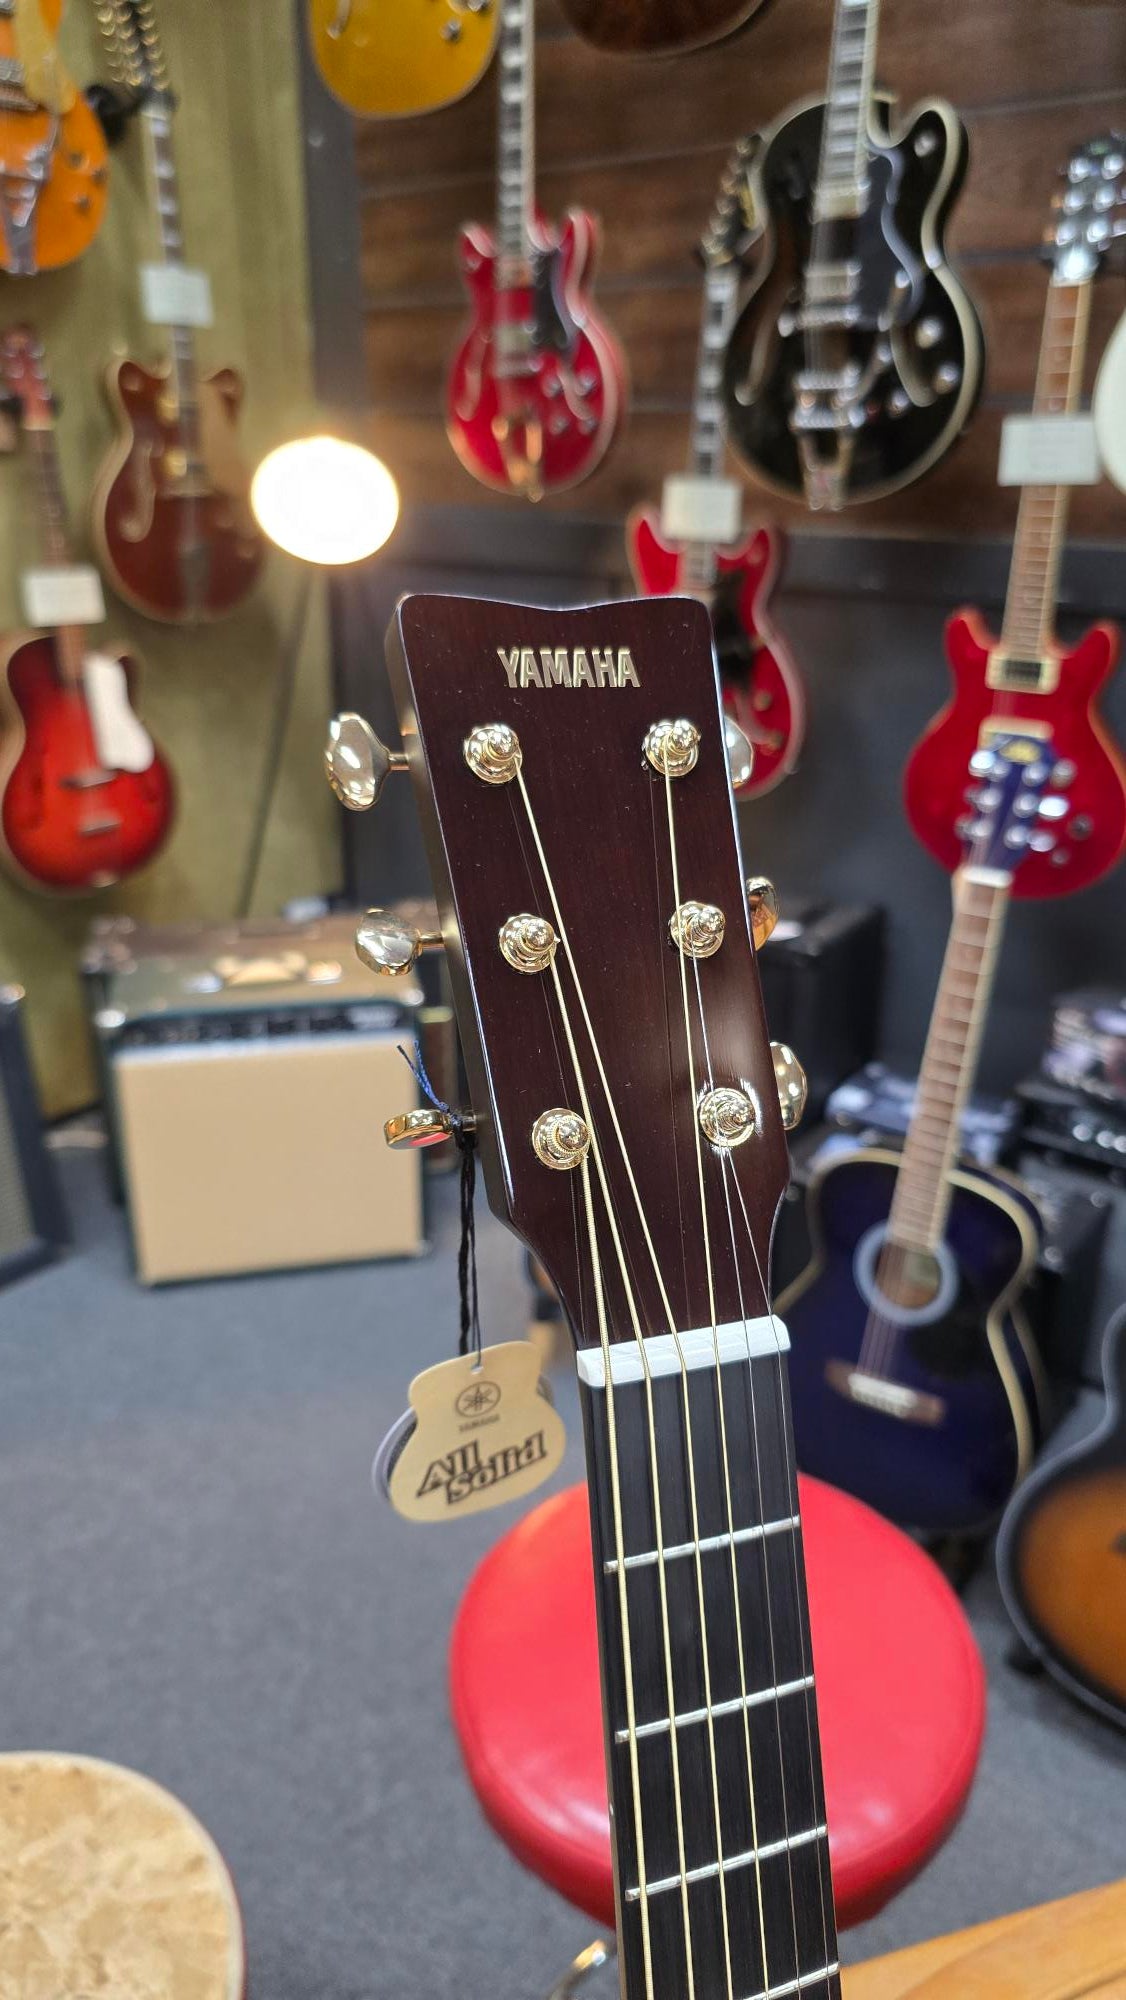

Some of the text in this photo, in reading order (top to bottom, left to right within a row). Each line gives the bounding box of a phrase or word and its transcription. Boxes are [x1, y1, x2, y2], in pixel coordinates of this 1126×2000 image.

[497, 647, 641, 688] YAMAHA
[416, 1439, 480, 1497] All
[447, 1430, 547, 1504] Solid
